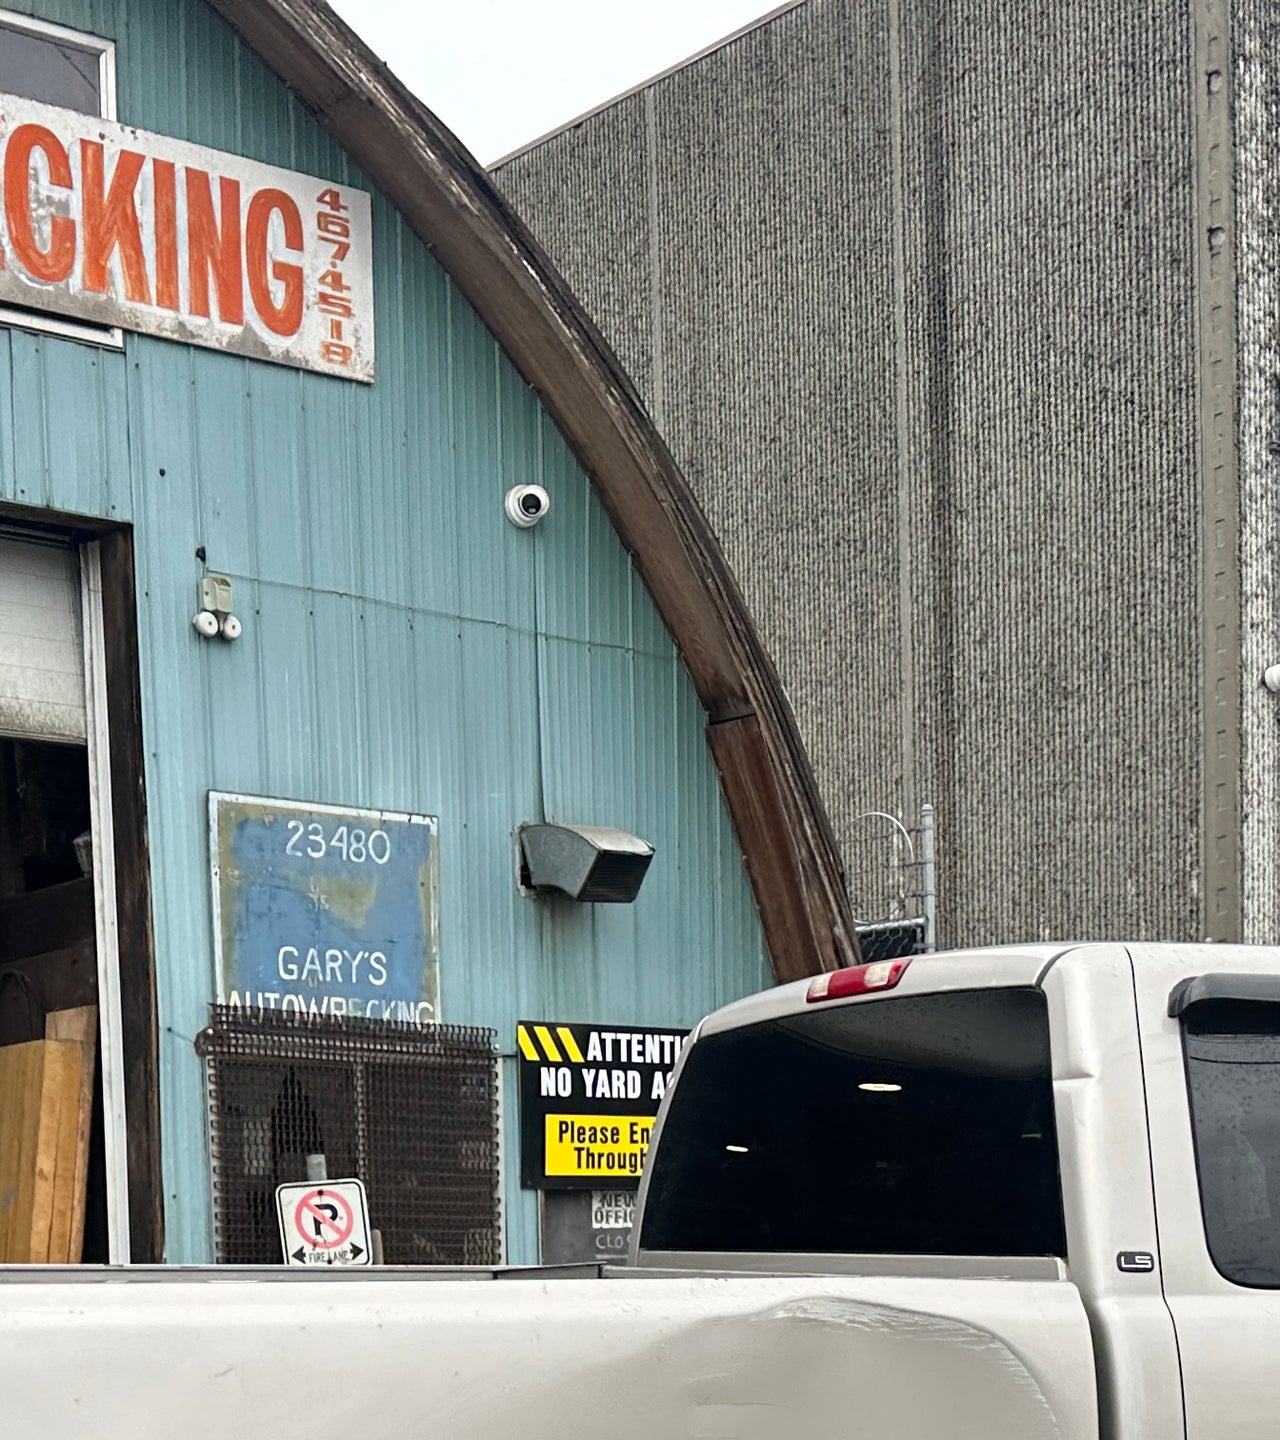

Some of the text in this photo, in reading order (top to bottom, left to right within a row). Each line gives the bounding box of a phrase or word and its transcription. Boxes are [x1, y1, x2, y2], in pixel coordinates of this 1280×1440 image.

[285, 819, 391, 865] 23480
[277, 945, 387, 987] GARY'S
[586, 1031, 689, 1065] ATTENTI
[540, 1066, 572, 1098] NO
[581, 1067, 642, 1100] YARD
[558, 1120, 655, 1145] Please En
[308, 1252, 327, 1263] FIRE
[1120, 1255, 1152, 1269] LS
